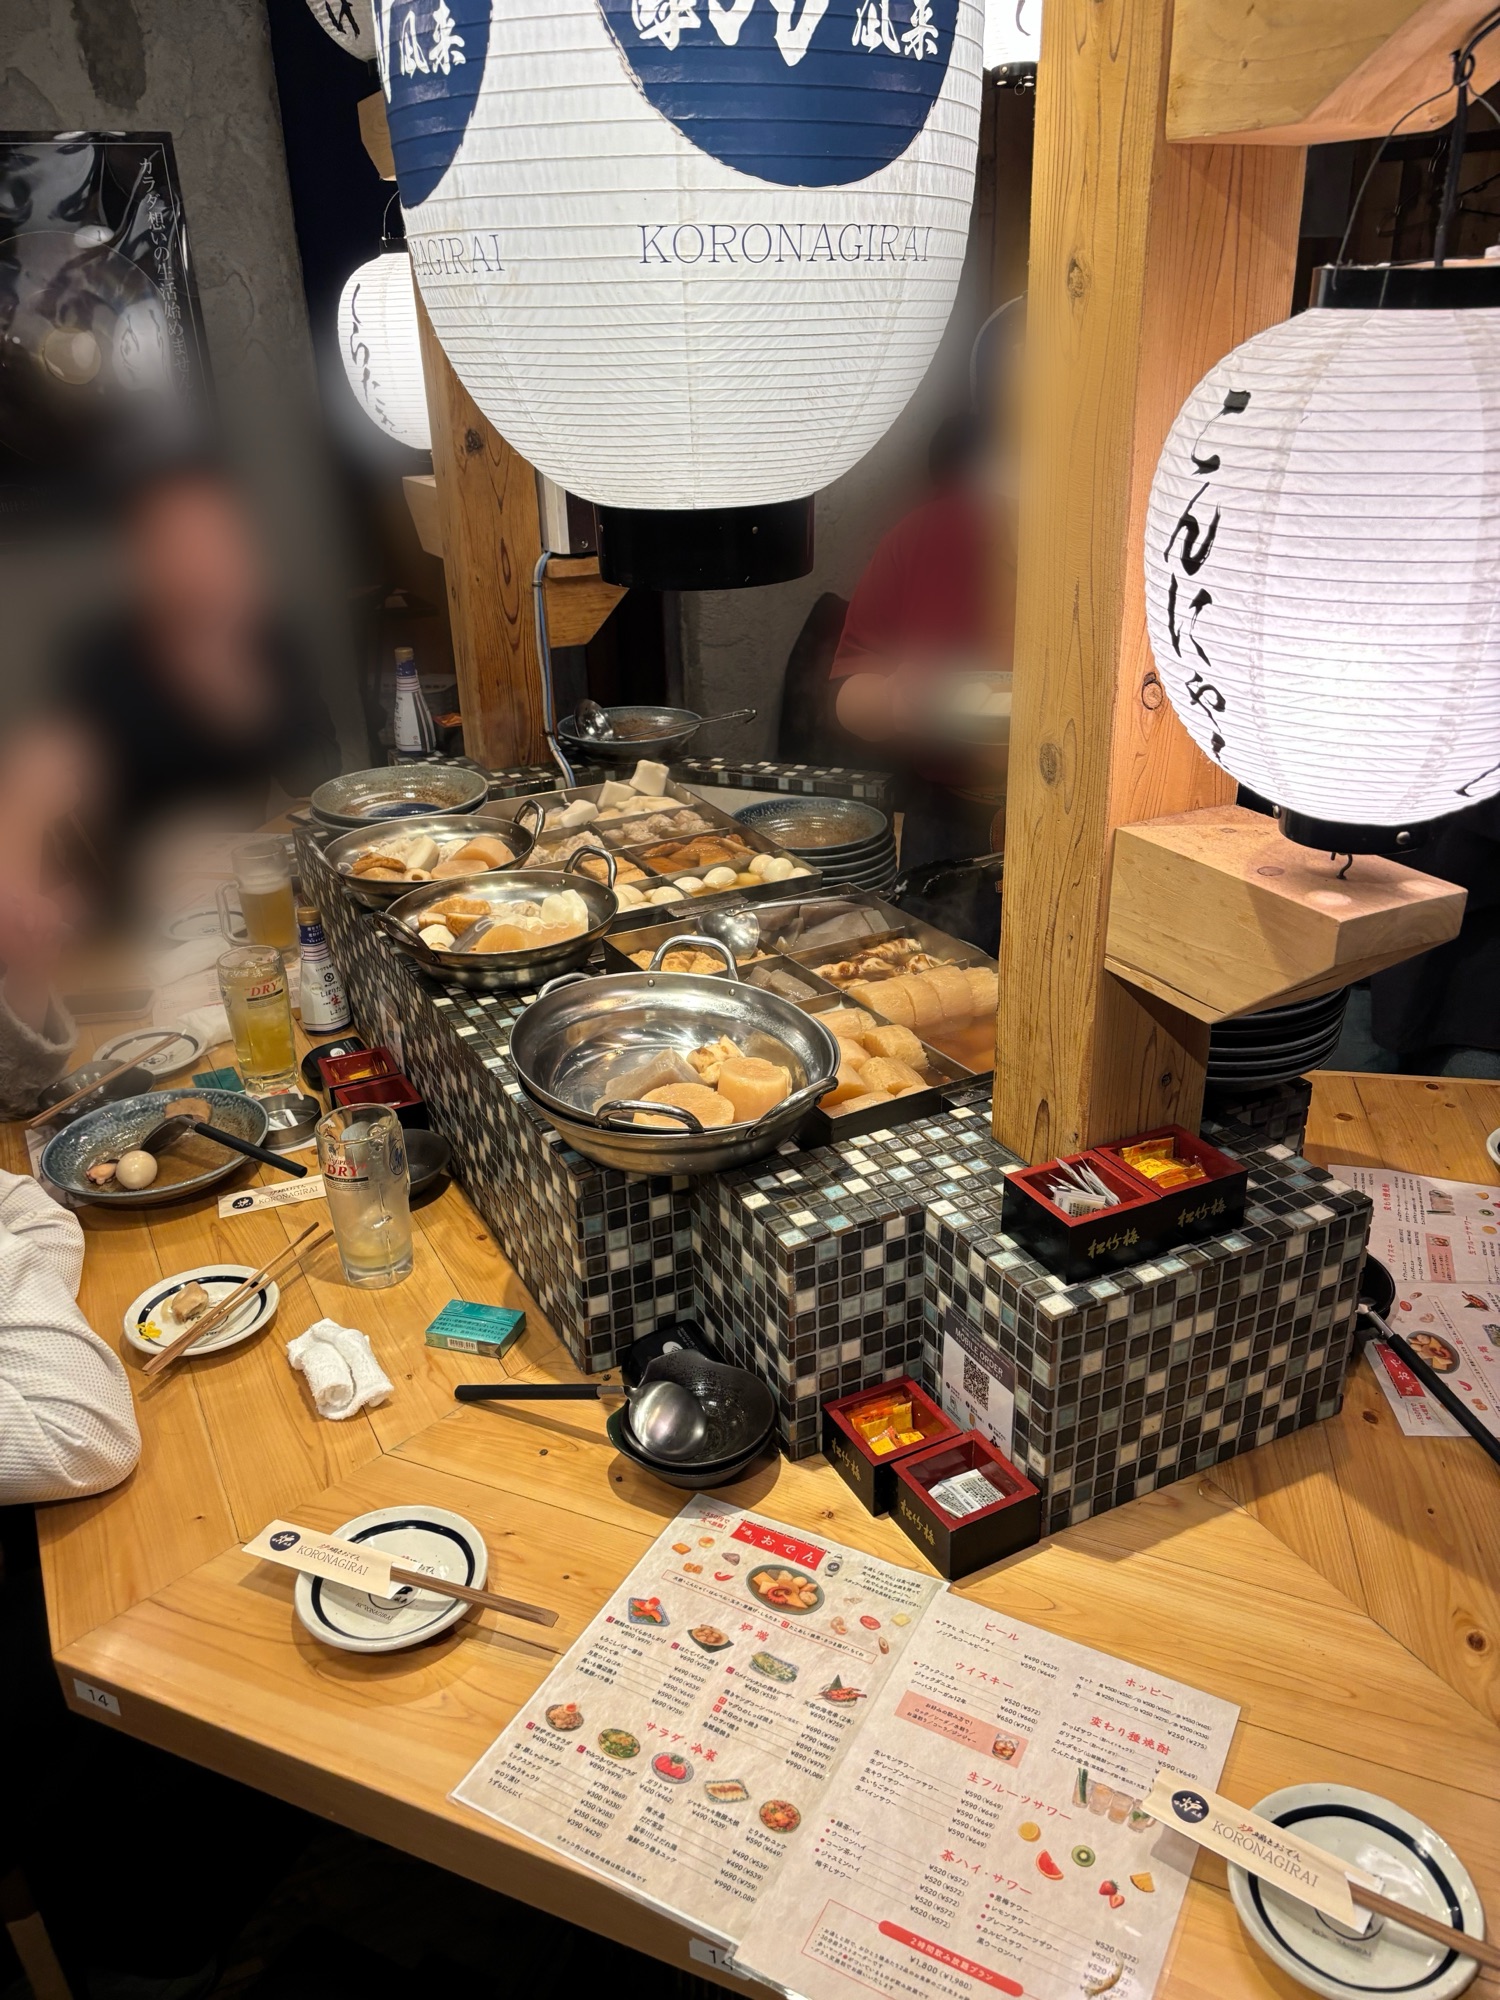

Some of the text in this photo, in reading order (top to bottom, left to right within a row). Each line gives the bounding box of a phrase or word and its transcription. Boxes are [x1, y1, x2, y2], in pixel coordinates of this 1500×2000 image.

[638, 223, 932, 265] KORONAGIRAI
[250, 981, 278, 997] DRY
[331, 994, 342, 1006] 生
[326, 1164, 358, 1177] DRY
[1178, 1198, 1228, 1228] 松竹梅
[1087, 1227, 1140, 1259] 松竹梅
[955, 1327, 979, 1355] MOBILE
[980, 1352, 1004, 1378] ORDER
[831, 1437, 861, 1482] 松竹梅
[900, 1499, 936, 1547] 松竹梅
[296, 1545, 369, 1576] KORONAGIRAI
[761, 1533, 815, 1565] おでん
[984, 1622, 1019, 1641] ビール
[955, 1662, 1014, 1689] ウイスキー
[1125, 1678, 1174, 1700] ホッピー
[88, 1689, 109, 1707] 14
[1090, 1716, 1171, 1756] 変わり種焼酎
[967, 1770, 1073, 1821] 生フルーツサワー
[832, 1831, 867, 1851] ウーロンハイ
[1212, 1820, 1319, 1887] KORONAGIRAI
[939, 1848, 1032, 1896] 茶ハイ・サワー
